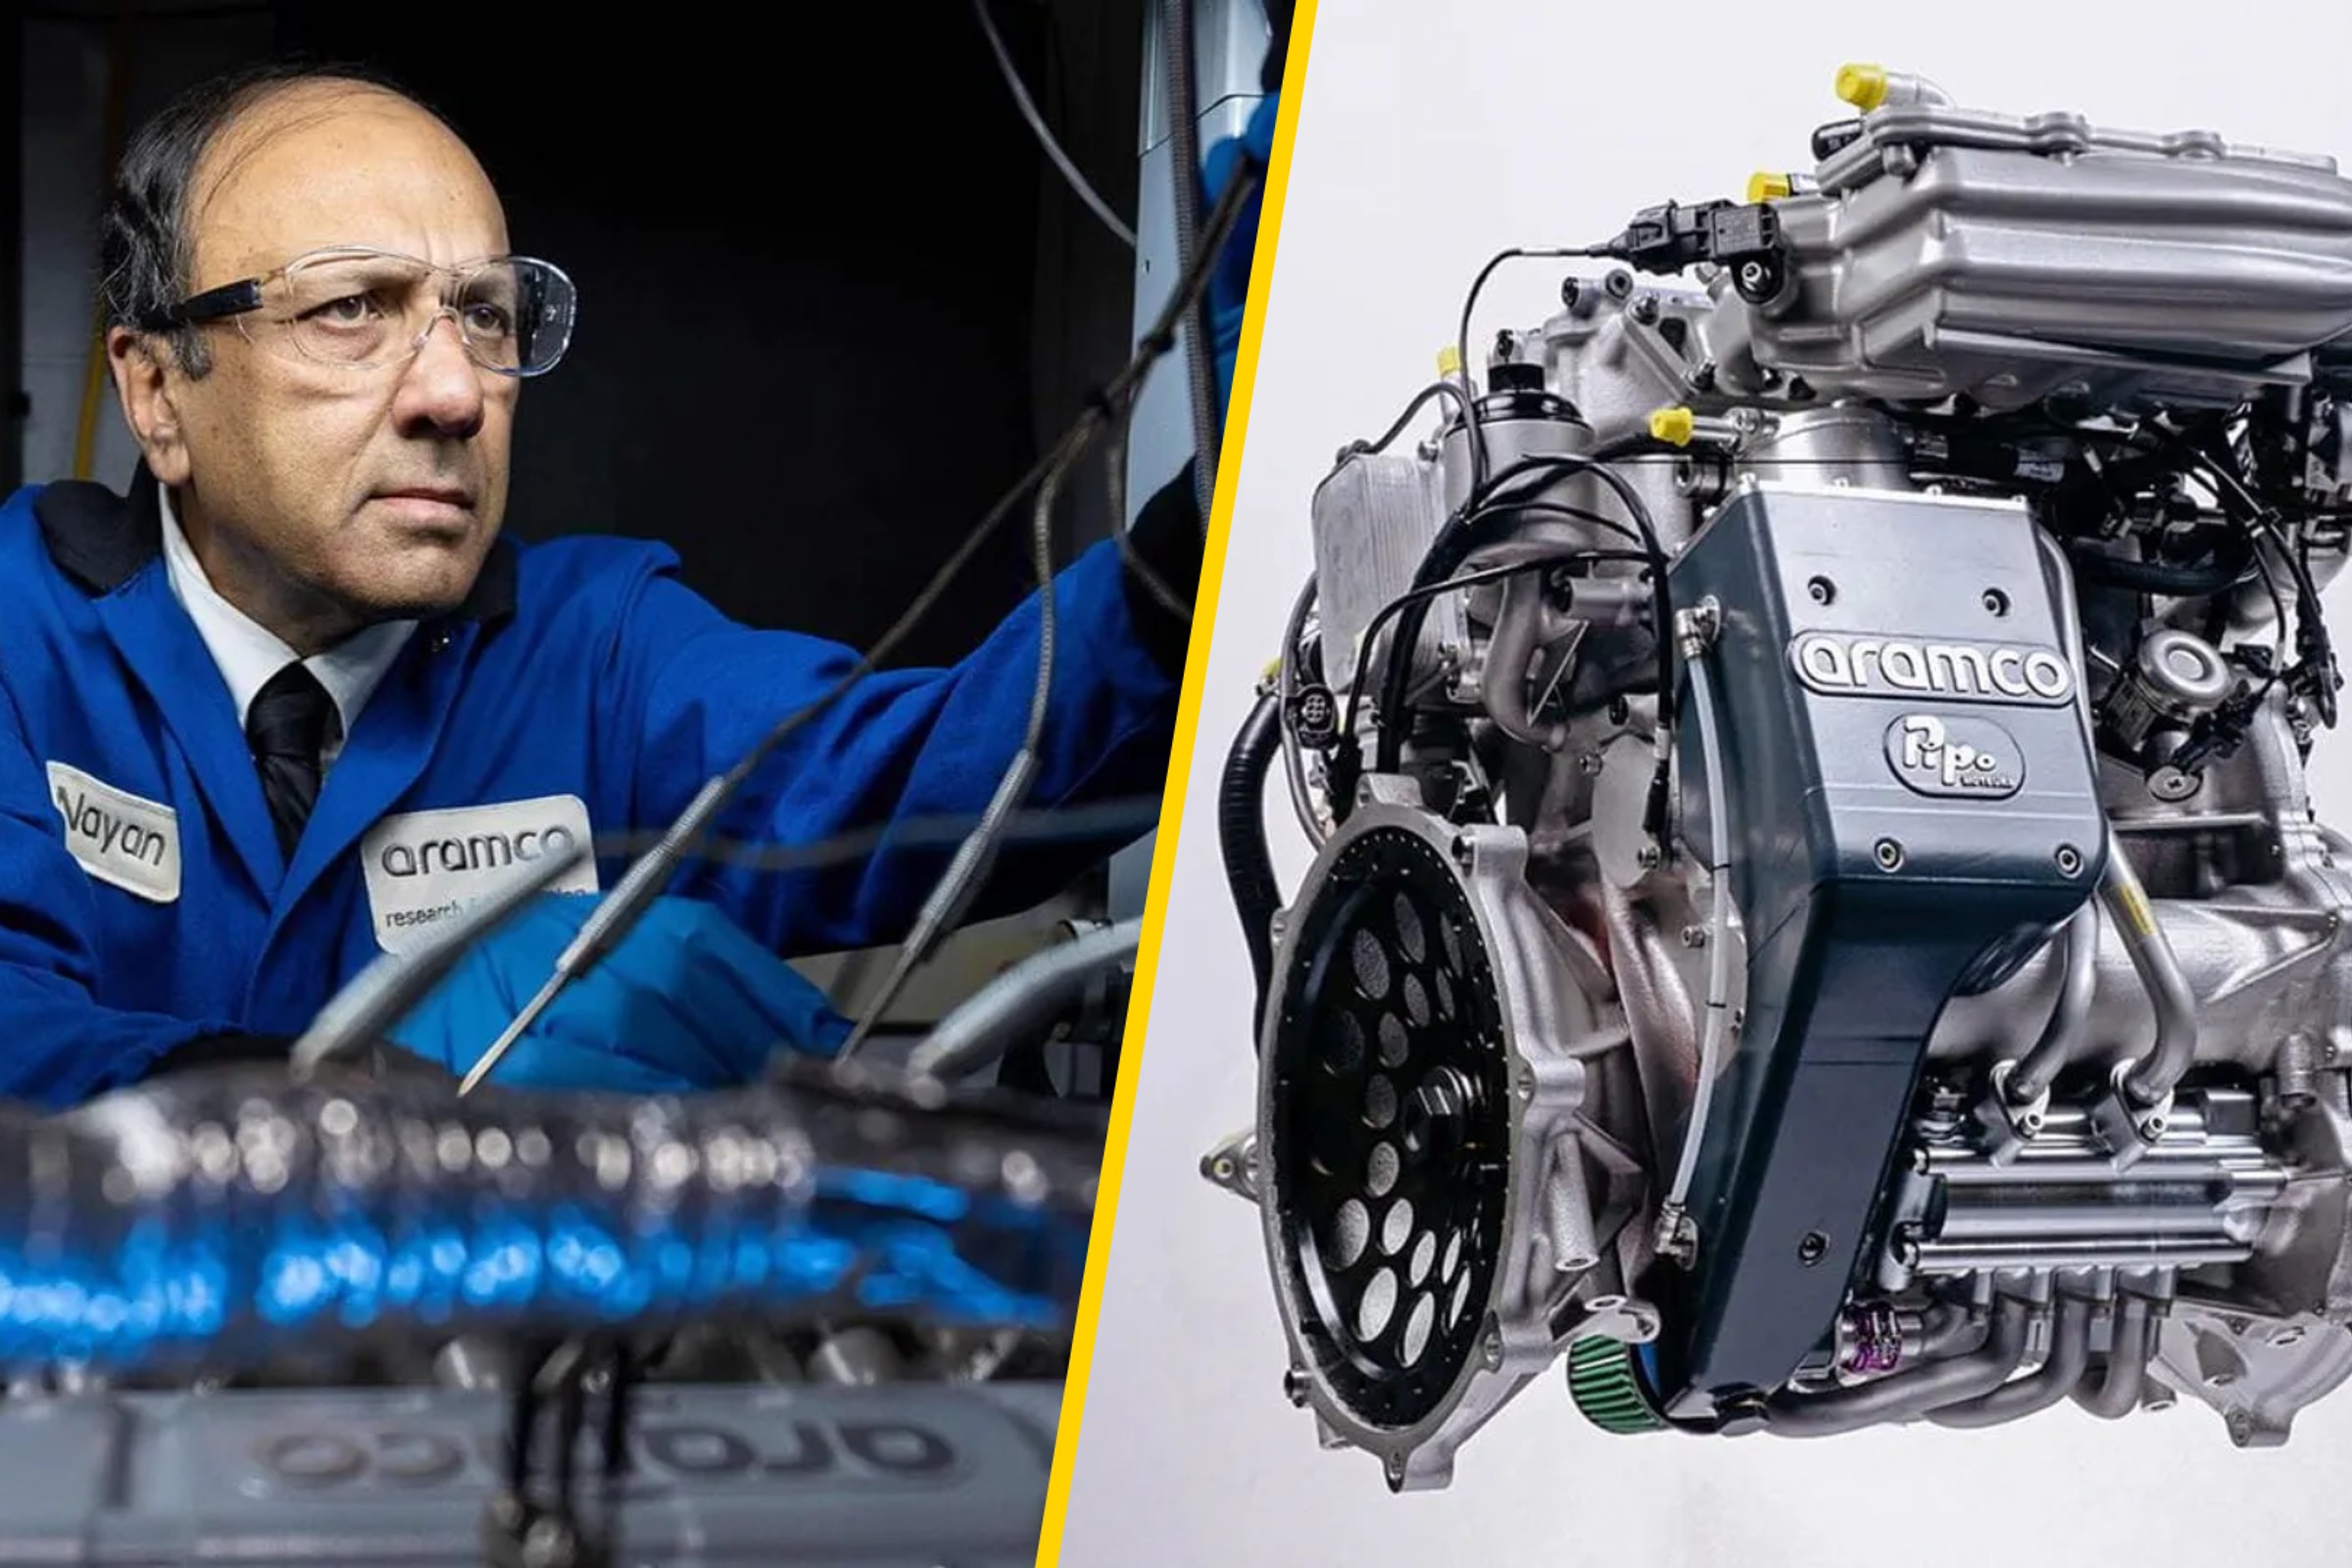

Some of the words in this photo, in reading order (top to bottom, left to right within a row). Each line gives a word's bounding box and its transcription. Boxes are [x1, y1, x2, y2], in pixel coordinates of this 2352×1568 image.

[1800, 636, 2072, 699] aramco
[1903, 714, 1996, 787] Pipo
[57, 786, 166, 866] Nayan
[381, 825, 575, 877] aramco
[262, 1421, 956, 1488] araco
